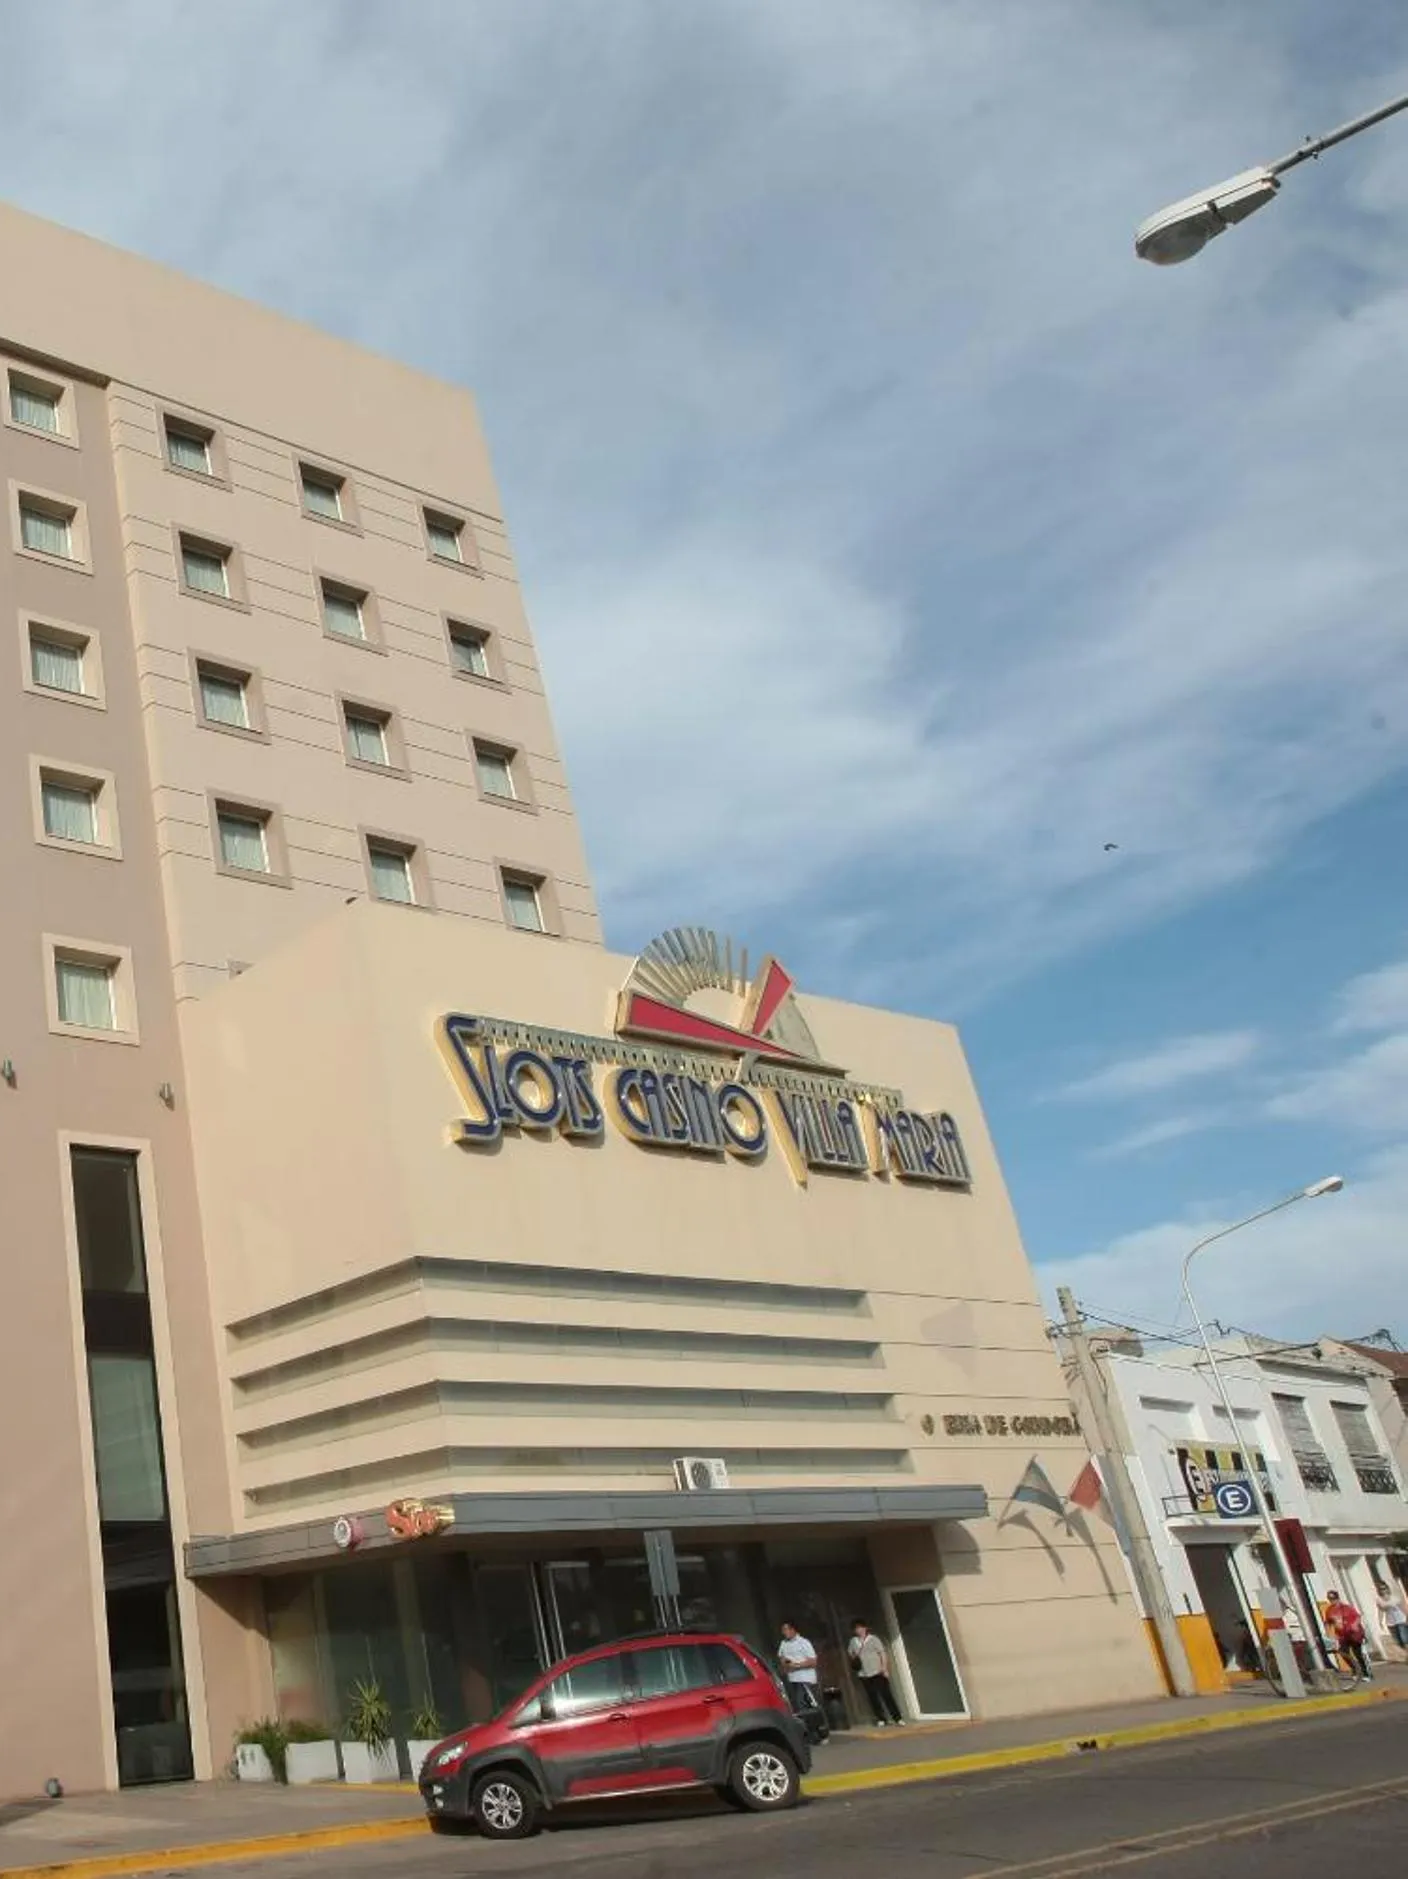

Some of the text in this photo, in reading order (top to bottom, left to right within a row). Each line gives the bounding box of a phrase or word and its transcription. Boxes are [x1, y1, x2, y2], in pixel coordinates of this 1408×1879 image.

[437, 1011, 604, 1143] SLOTS
[606, 1068, 768, 1156] CASINO
[766, 1086, 869, 1187] VILLA
[1225, 1490, 1244, 1509] E
